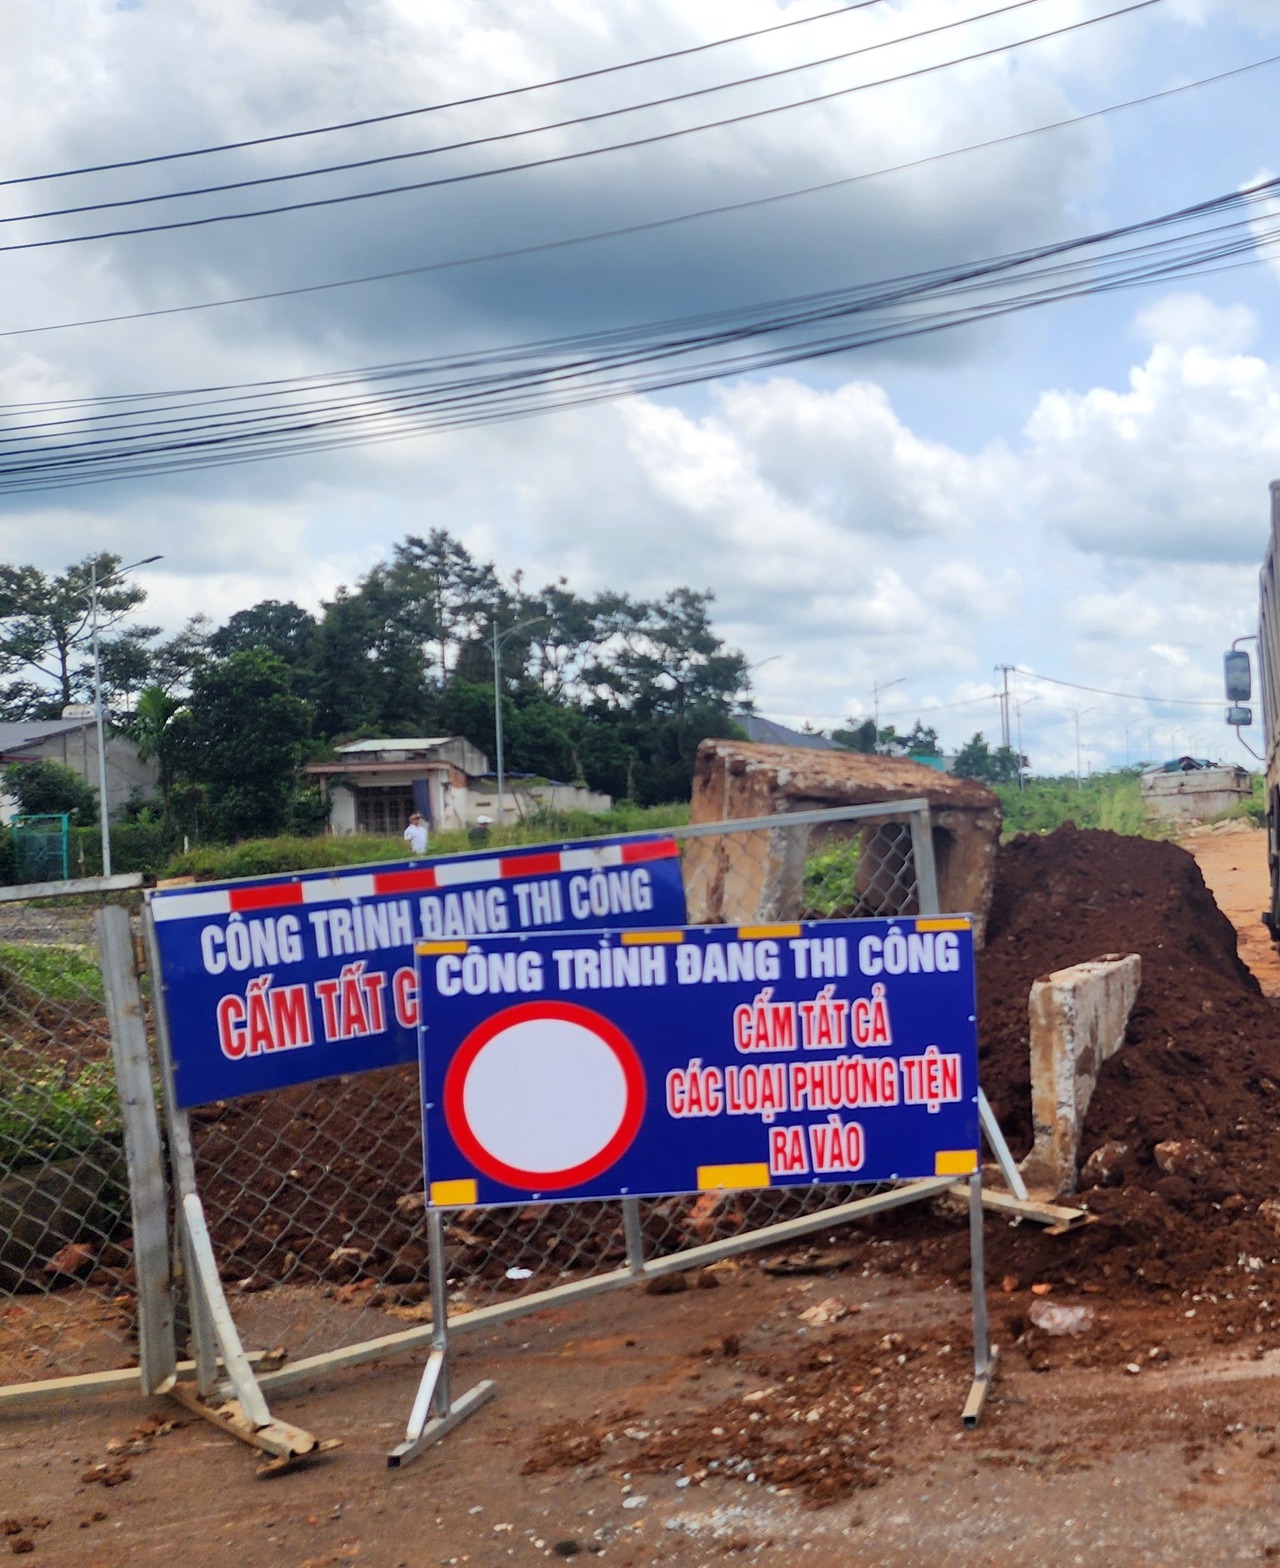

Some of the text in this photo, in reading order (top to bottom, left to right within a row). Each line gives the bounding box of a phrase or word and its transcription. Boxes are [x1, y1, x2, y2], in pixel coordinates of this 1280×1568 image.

[200, 866, 653, 975] CÔNG TRÌNH ĐANG THI CÔNG
[436, 926, 960, 996] CÔNG TRÌNH ĐANG THI CÔNG
[216, 973, 314, 1061] CẤM
[314, 959, 387, 1043] TẤT
[733, 982, 892, 1053] CẤM TẤT CẢ
[666, 1045, 962, 1123] CÁC LOẠI PHƯƠNG TIỆN
[769, 1114, 865, 1176] RA VÀO
